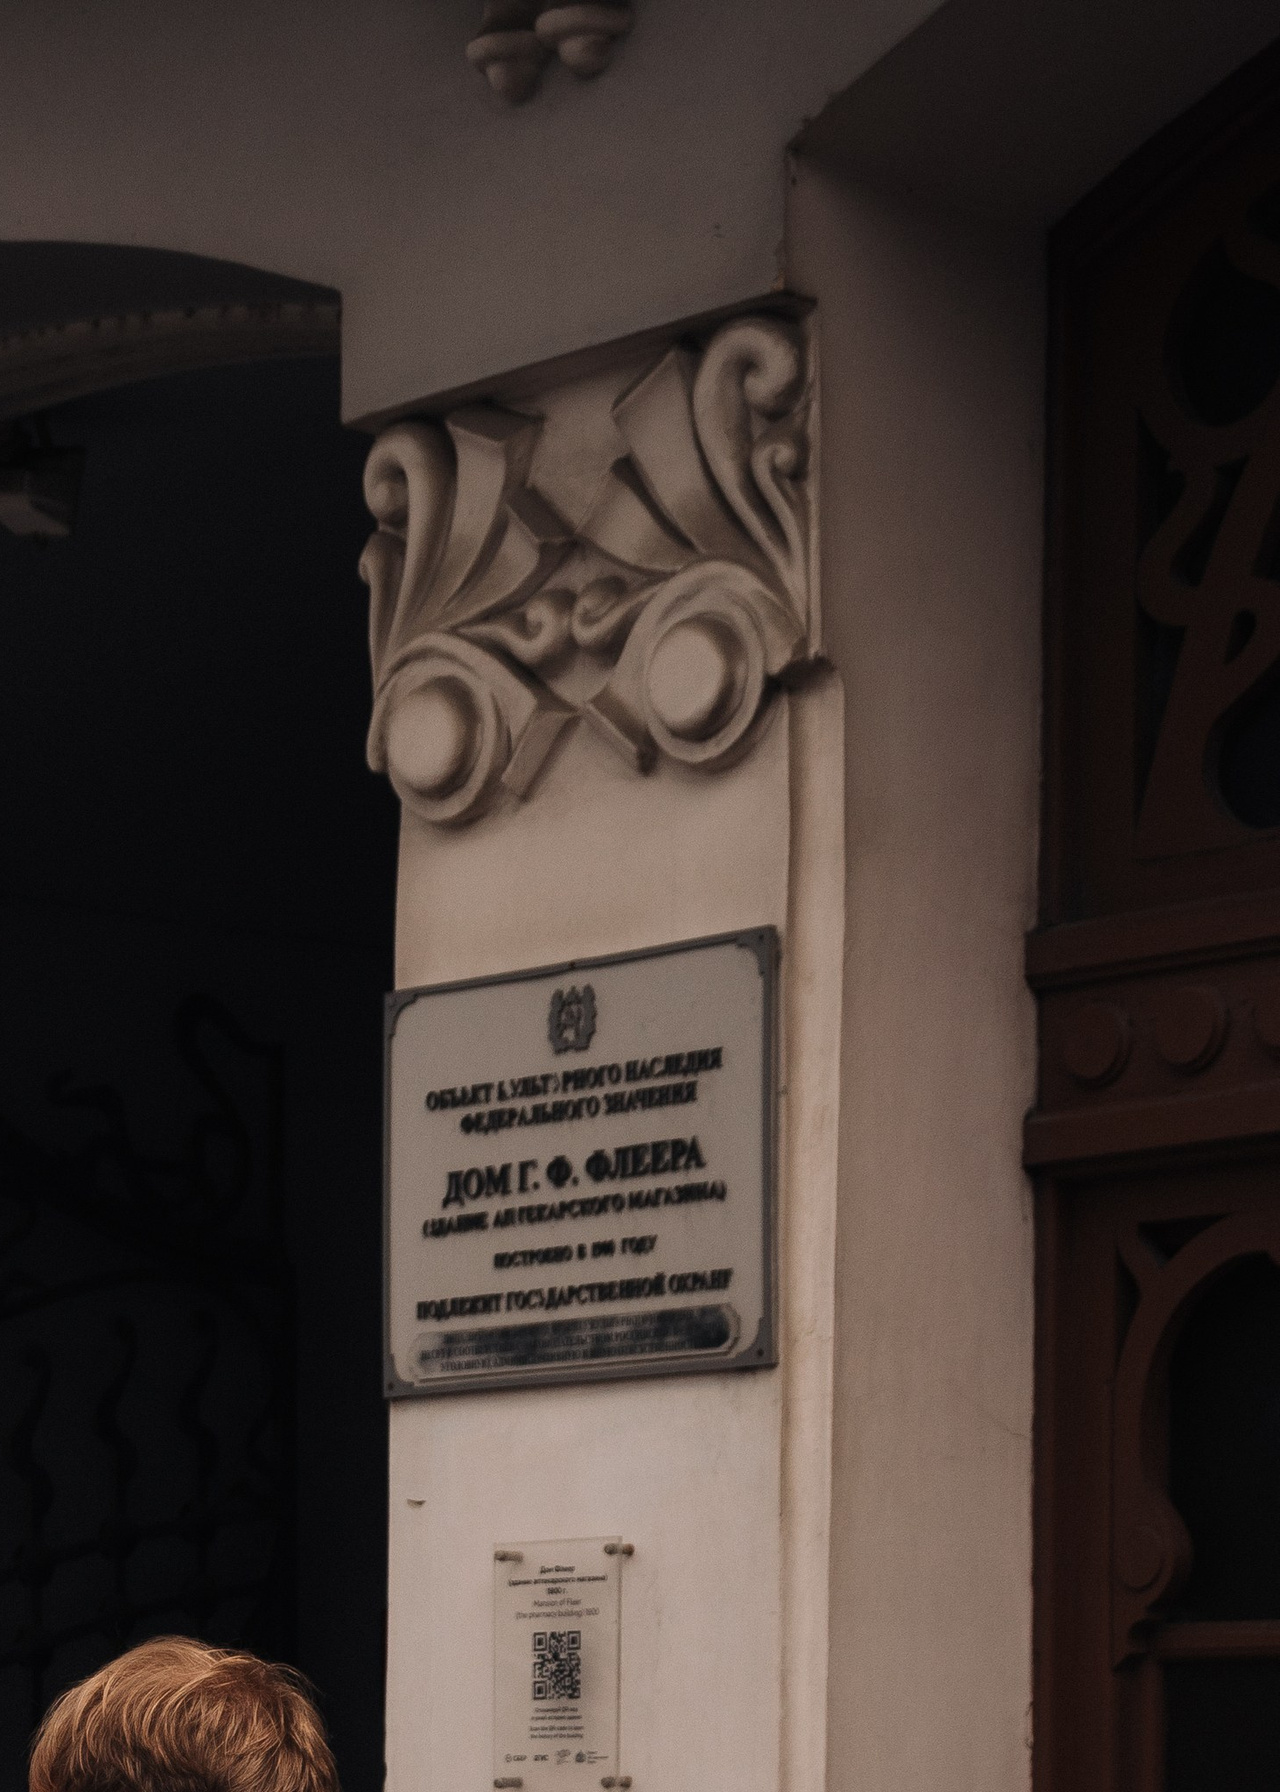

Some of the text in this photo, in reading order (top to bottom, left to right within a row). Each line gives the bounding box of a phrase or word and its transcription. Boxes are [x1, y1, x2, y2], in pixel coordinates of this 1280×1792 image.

[624, 1046, 723, 1083] НАСЛЕДИЯ
[460, 1080, 698, 1135] ФЕДЕРАЛЬНОГО ЗНАЧЕНИЯ
[441, 1135, 706, 1209] ДОМ Г. Ф. ФЛЕЕРА
[620, 1234, 658, 1256] ГОДУ
[416, 1293, 503, 1321] ПОДЛЕЖИТ
[506, 1271, 666, 1311] ГОСУДАРСТВЕННОЙ
